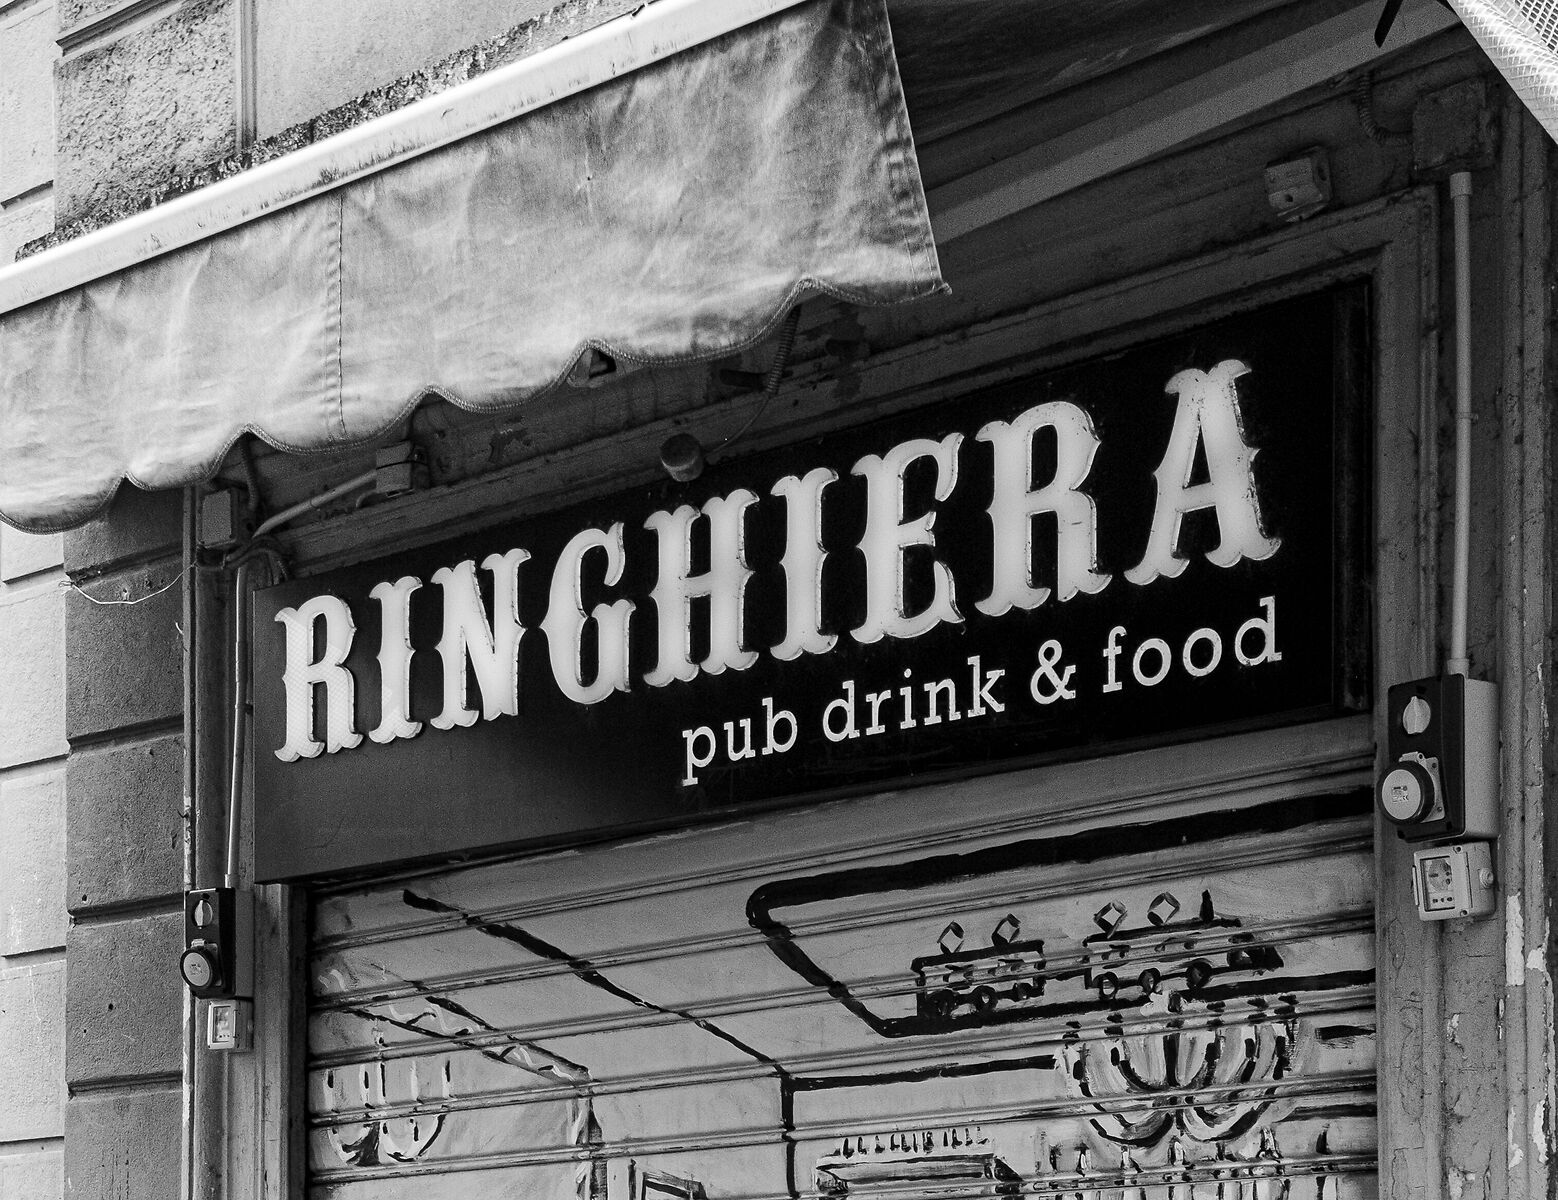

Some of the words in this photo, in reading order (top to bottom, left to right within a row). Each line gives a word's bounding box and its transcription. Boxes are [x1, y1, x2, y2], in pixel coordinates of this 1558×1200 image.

[274, 359, 1282, 763] RINGHIERA
[682, 697, 798, 787] pub
[822, 655, 1006, 743] drink
[1030, 639, 1077, 705] &
[1102, 595, 1283, 694] food
